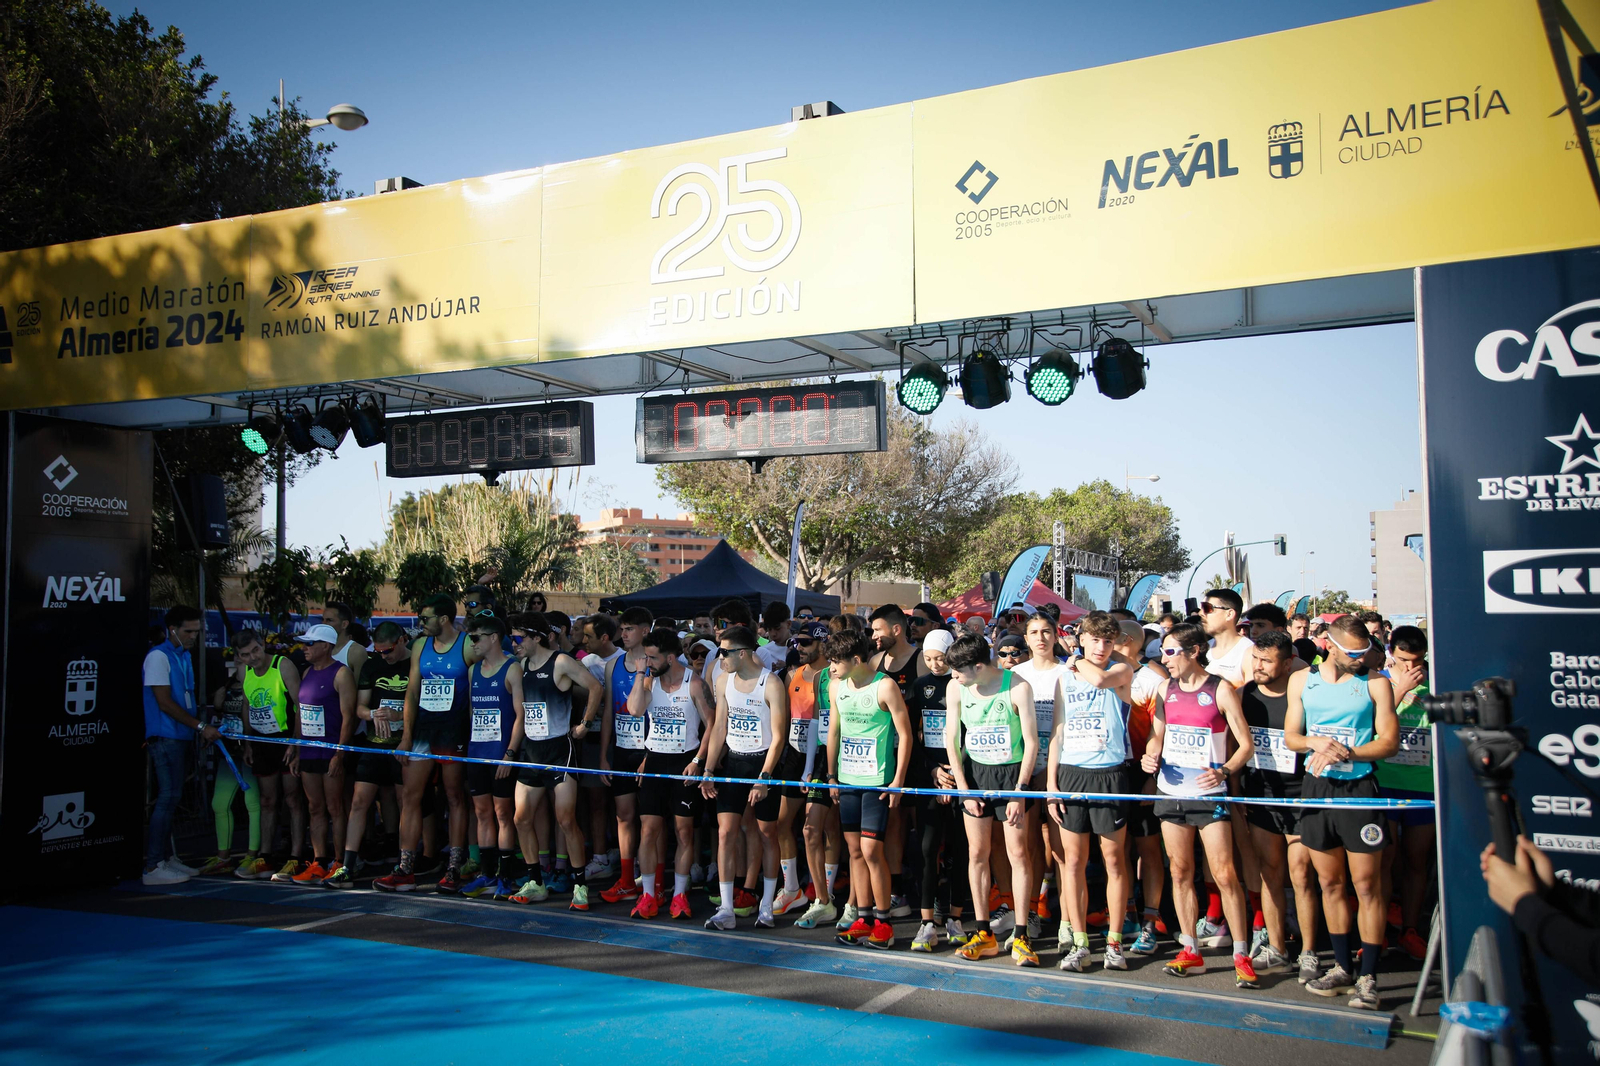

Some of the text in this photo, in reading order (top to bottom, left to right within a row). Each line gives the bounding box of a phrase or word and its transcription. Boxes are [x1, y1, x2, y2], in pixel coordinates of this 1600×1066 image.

[1338, 85, 1511, 141] ALMERÍA
[1338, 136, 1422, 165] CIUDAD
[1109, 194, 1136, 207] 2020
[650, 147, 802, 284] 25
[955, 197, 1069, 226] COOPERACIÓN
[955, 224, 993, 240] 2005
[313, 266, 359, 282] RFEA
[309, 280, 354, 294] SERIES
[60, 277, 244, 321] Medio Maratón
[305, 289, 380, 306] RUTA RUNNING
[648, 277, 801, 327] EDICIÓN
[17, 301, 40, 327] 25
[261, 296, 481, 339] RAMÓN RUIZ ANDÚJAR
[17, 327, 41, 337] EDICIÓN
[58, 318, 159, 359] Almería
[166, 309, 244, 348] 2024
[42, 493, 128, 510] COOPERACIÓN
[1526, 499, 1553, 511] DE
[42, 505, 72, 517] 2005
[1029, 553, 1041, 573] azul
[49, 601, 68, 609] 2020
[425, 685, 451, 695] 5610
[250, 710, 272, 721] 5845
[474, 715, 497, 725] 5784
[48, 719, 110, 739] ALMERÍA
[617, 721, 641, 732] 5770
[653, 723, 681, 736] 5541
[731, 719, 757, 732] 5492
[1068, 718, 1102, 731] 5562
[63, 735, 96, 747] CIUDAD
[970, 734, 1005, 746] 5686
[1171, 732, 1206, 748] 5600
[844, 743, 871, 756] 5707
[1531, 795, 1593, 817] SER
[41, 841, 81, 854] DEPORTES
[1536, 836, 1554, 847] La
[1555, 837, 1582, 849] Voz
